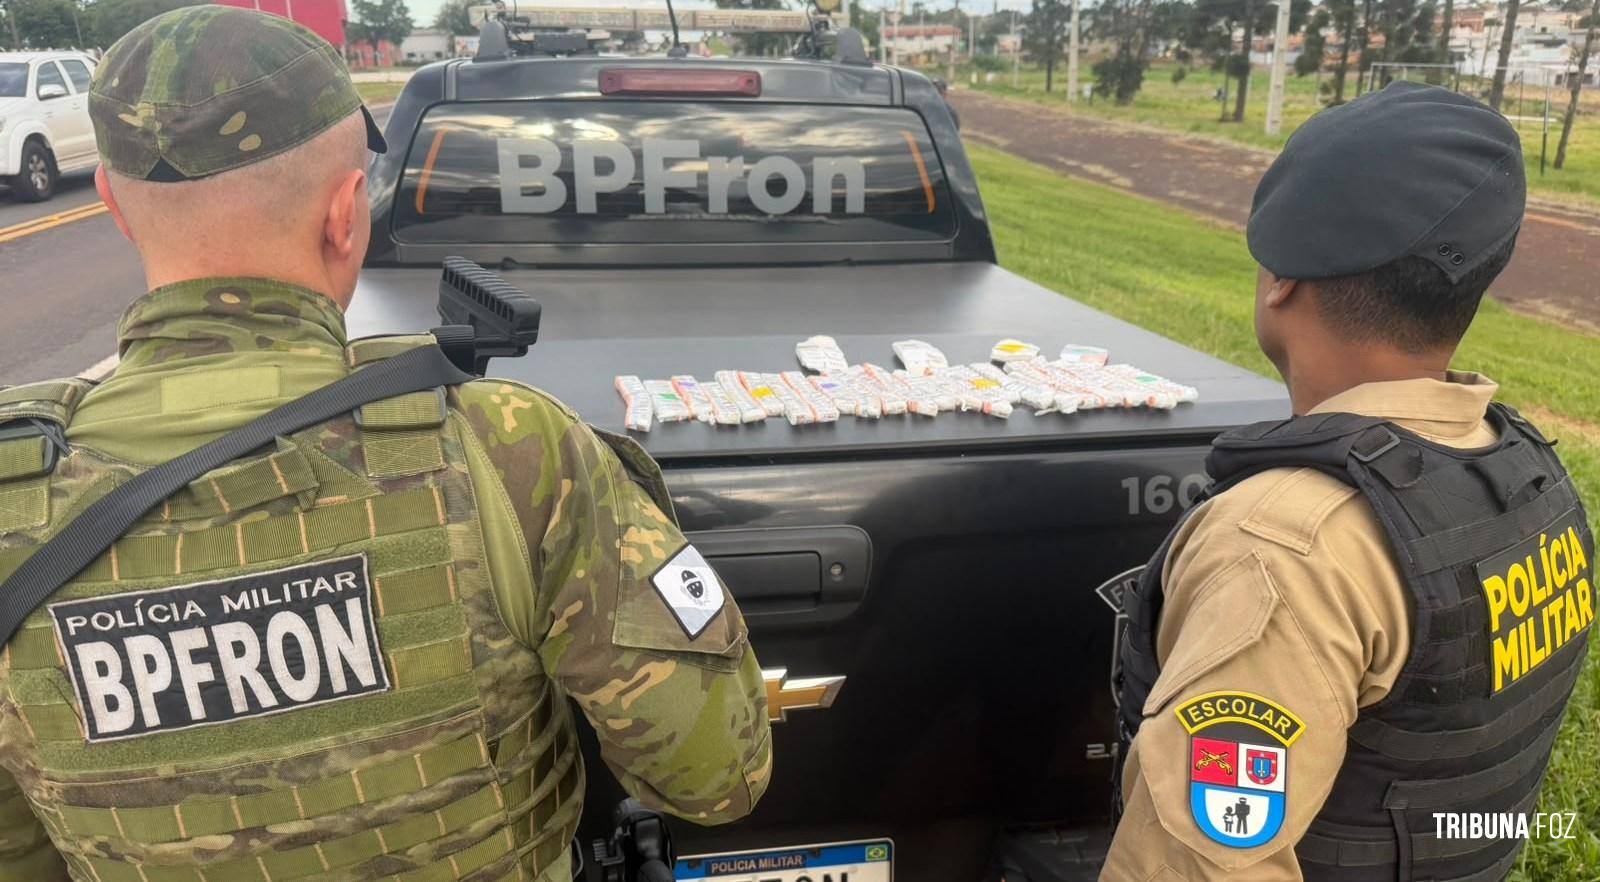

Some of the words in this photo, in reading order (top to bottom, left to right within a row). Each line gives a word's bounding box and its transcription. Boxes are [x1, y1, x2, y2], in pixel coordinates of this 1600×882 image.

[496, 138, 865, 214] BPFron
[65, 598, 205, 636] POLÍCIA
[221, 571, 358, 614] MILITAR
[1482, 526, 1588, 633] POLÍCIA
[74, 597, 377, 734] BPFRON
[1493, 578, 1594, 692] MILITAR
[1187, 698, 1291, 735] ESCOLAR
[711, 859, 756, 873] POLÍCIA
[758, 855, 804, 869] MILITAR
